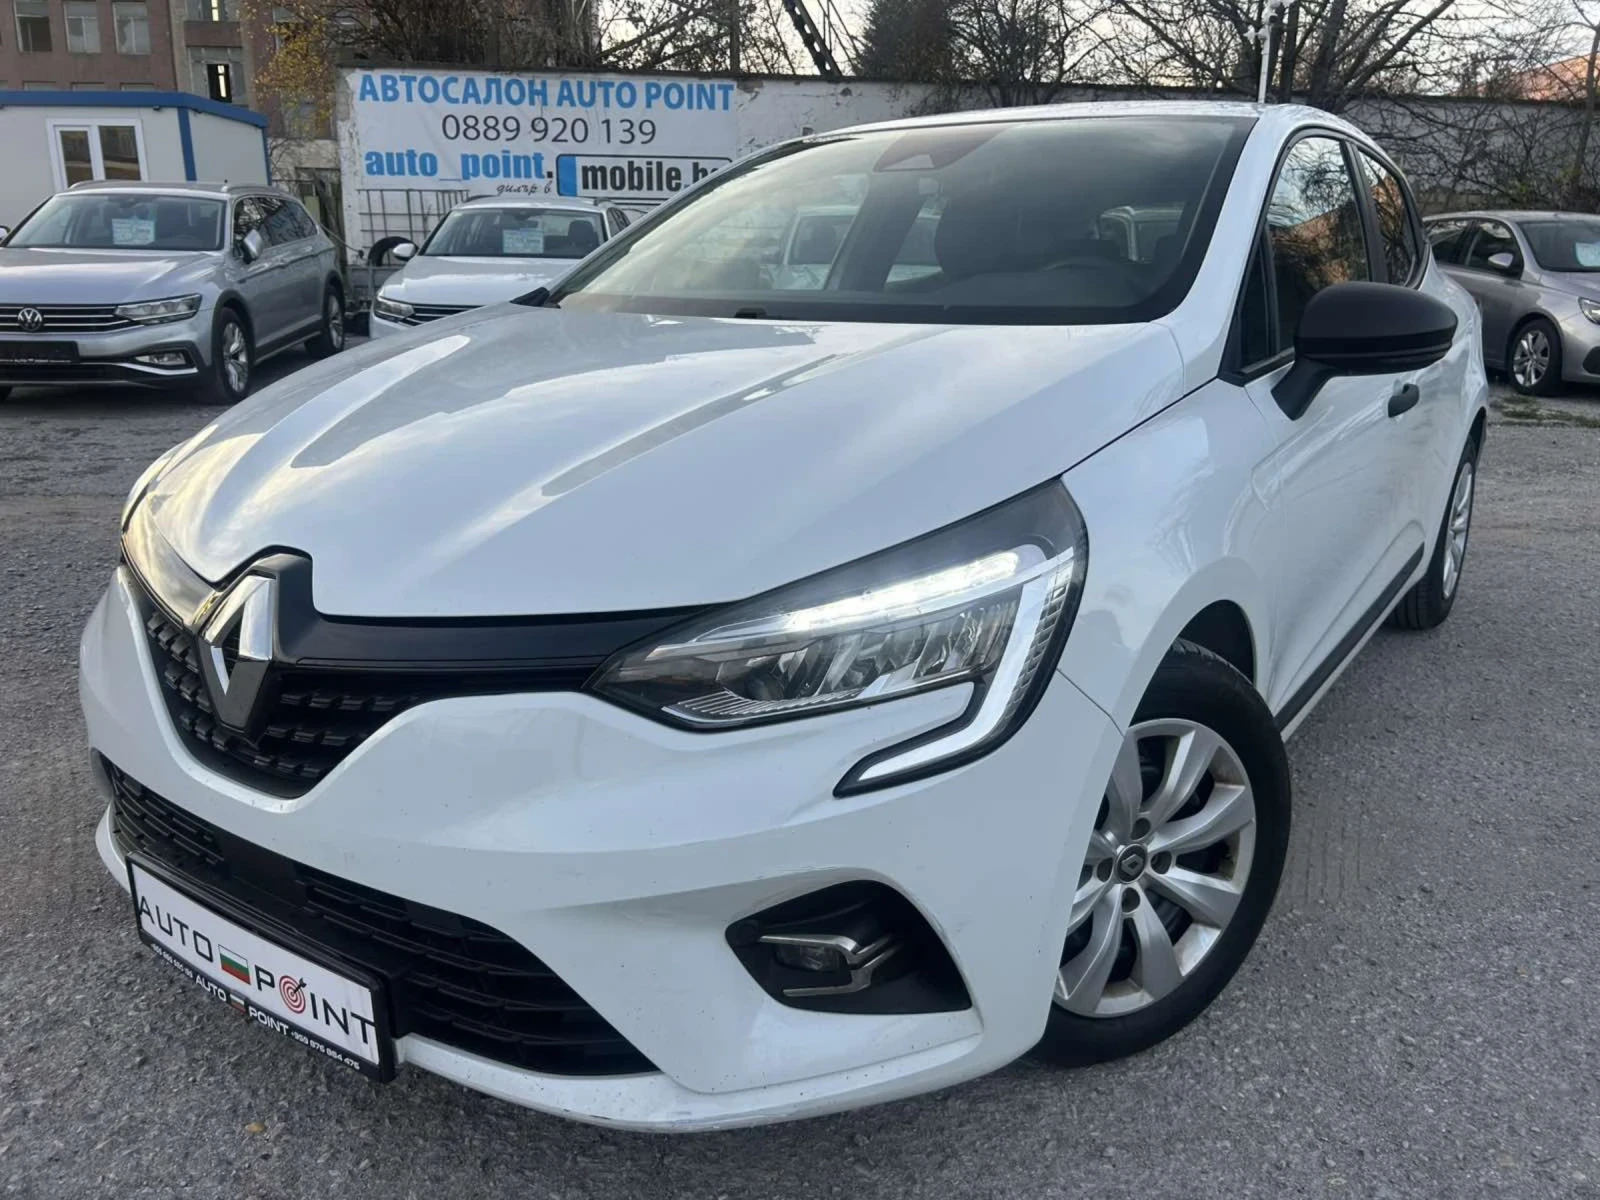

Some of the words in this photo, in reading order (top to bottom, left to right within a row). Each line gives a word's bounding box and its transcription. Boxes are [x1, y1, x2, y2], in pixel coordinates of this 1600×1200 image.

[359, 74, 548, 106] АВТОСАЛОН
[557, 79, 637, 108] AUTO
[645, 82, 735, 111] POINT
[442, 114, 521, 141] 0889
[530, 117, 588, 143] 920
[601, 118, 656, 145] 139
[581, 160, 718, 192] mobile.b
[139, 895, 213, 963] AUTO
[196, 975, 227, 1002] AUTO
[248, 1006, 289, 1036] POINT
